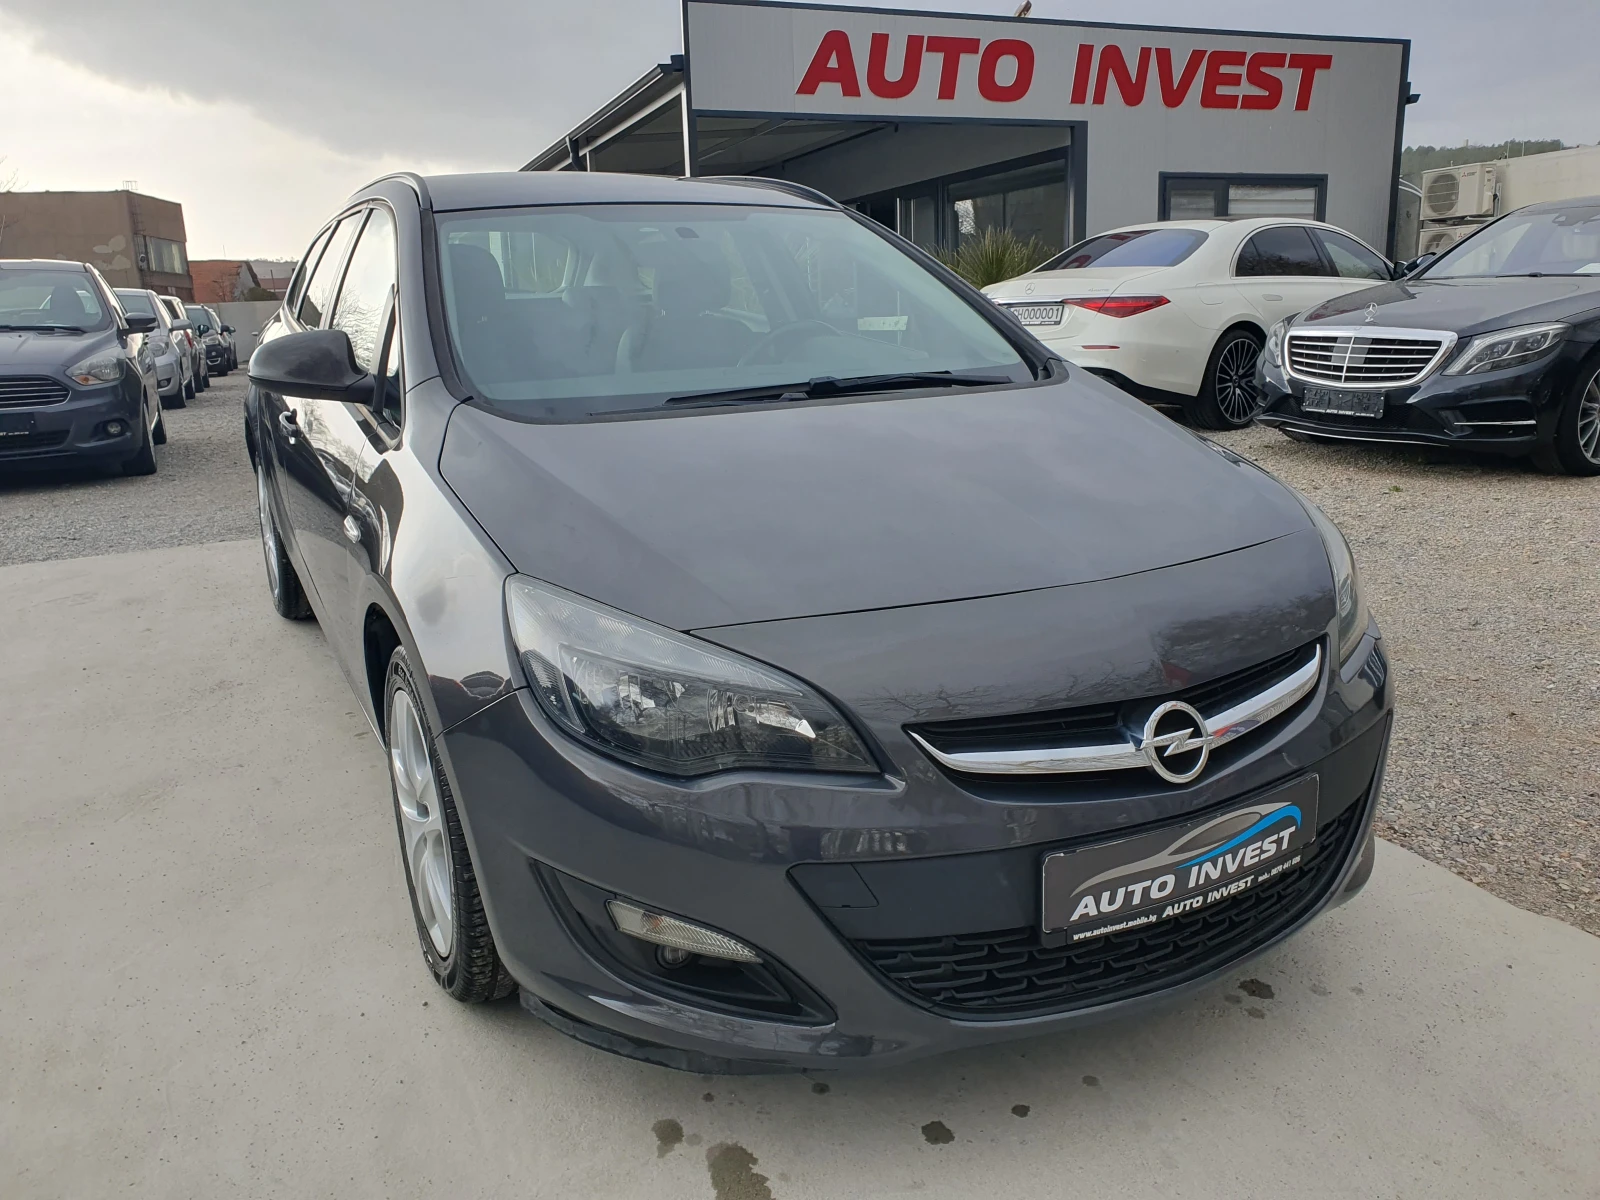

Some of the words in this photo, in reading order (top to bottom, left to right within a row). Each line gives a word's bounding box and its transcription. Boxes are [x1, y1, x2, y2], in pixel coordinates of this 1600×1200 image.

[795, 29, 1035, 103] AUTO
[1069, 43, 1333, 111] INVEST
[1069, 874, 1176, 921] AUTO
[1188, 825, 1296, 889] INVEST
[1073, 914, 1157, 940] www.autoinvest.mobile.bg
[1162, 895, 1203, 918] AUTO
[1207, 875, 1255, 904] INVEST
